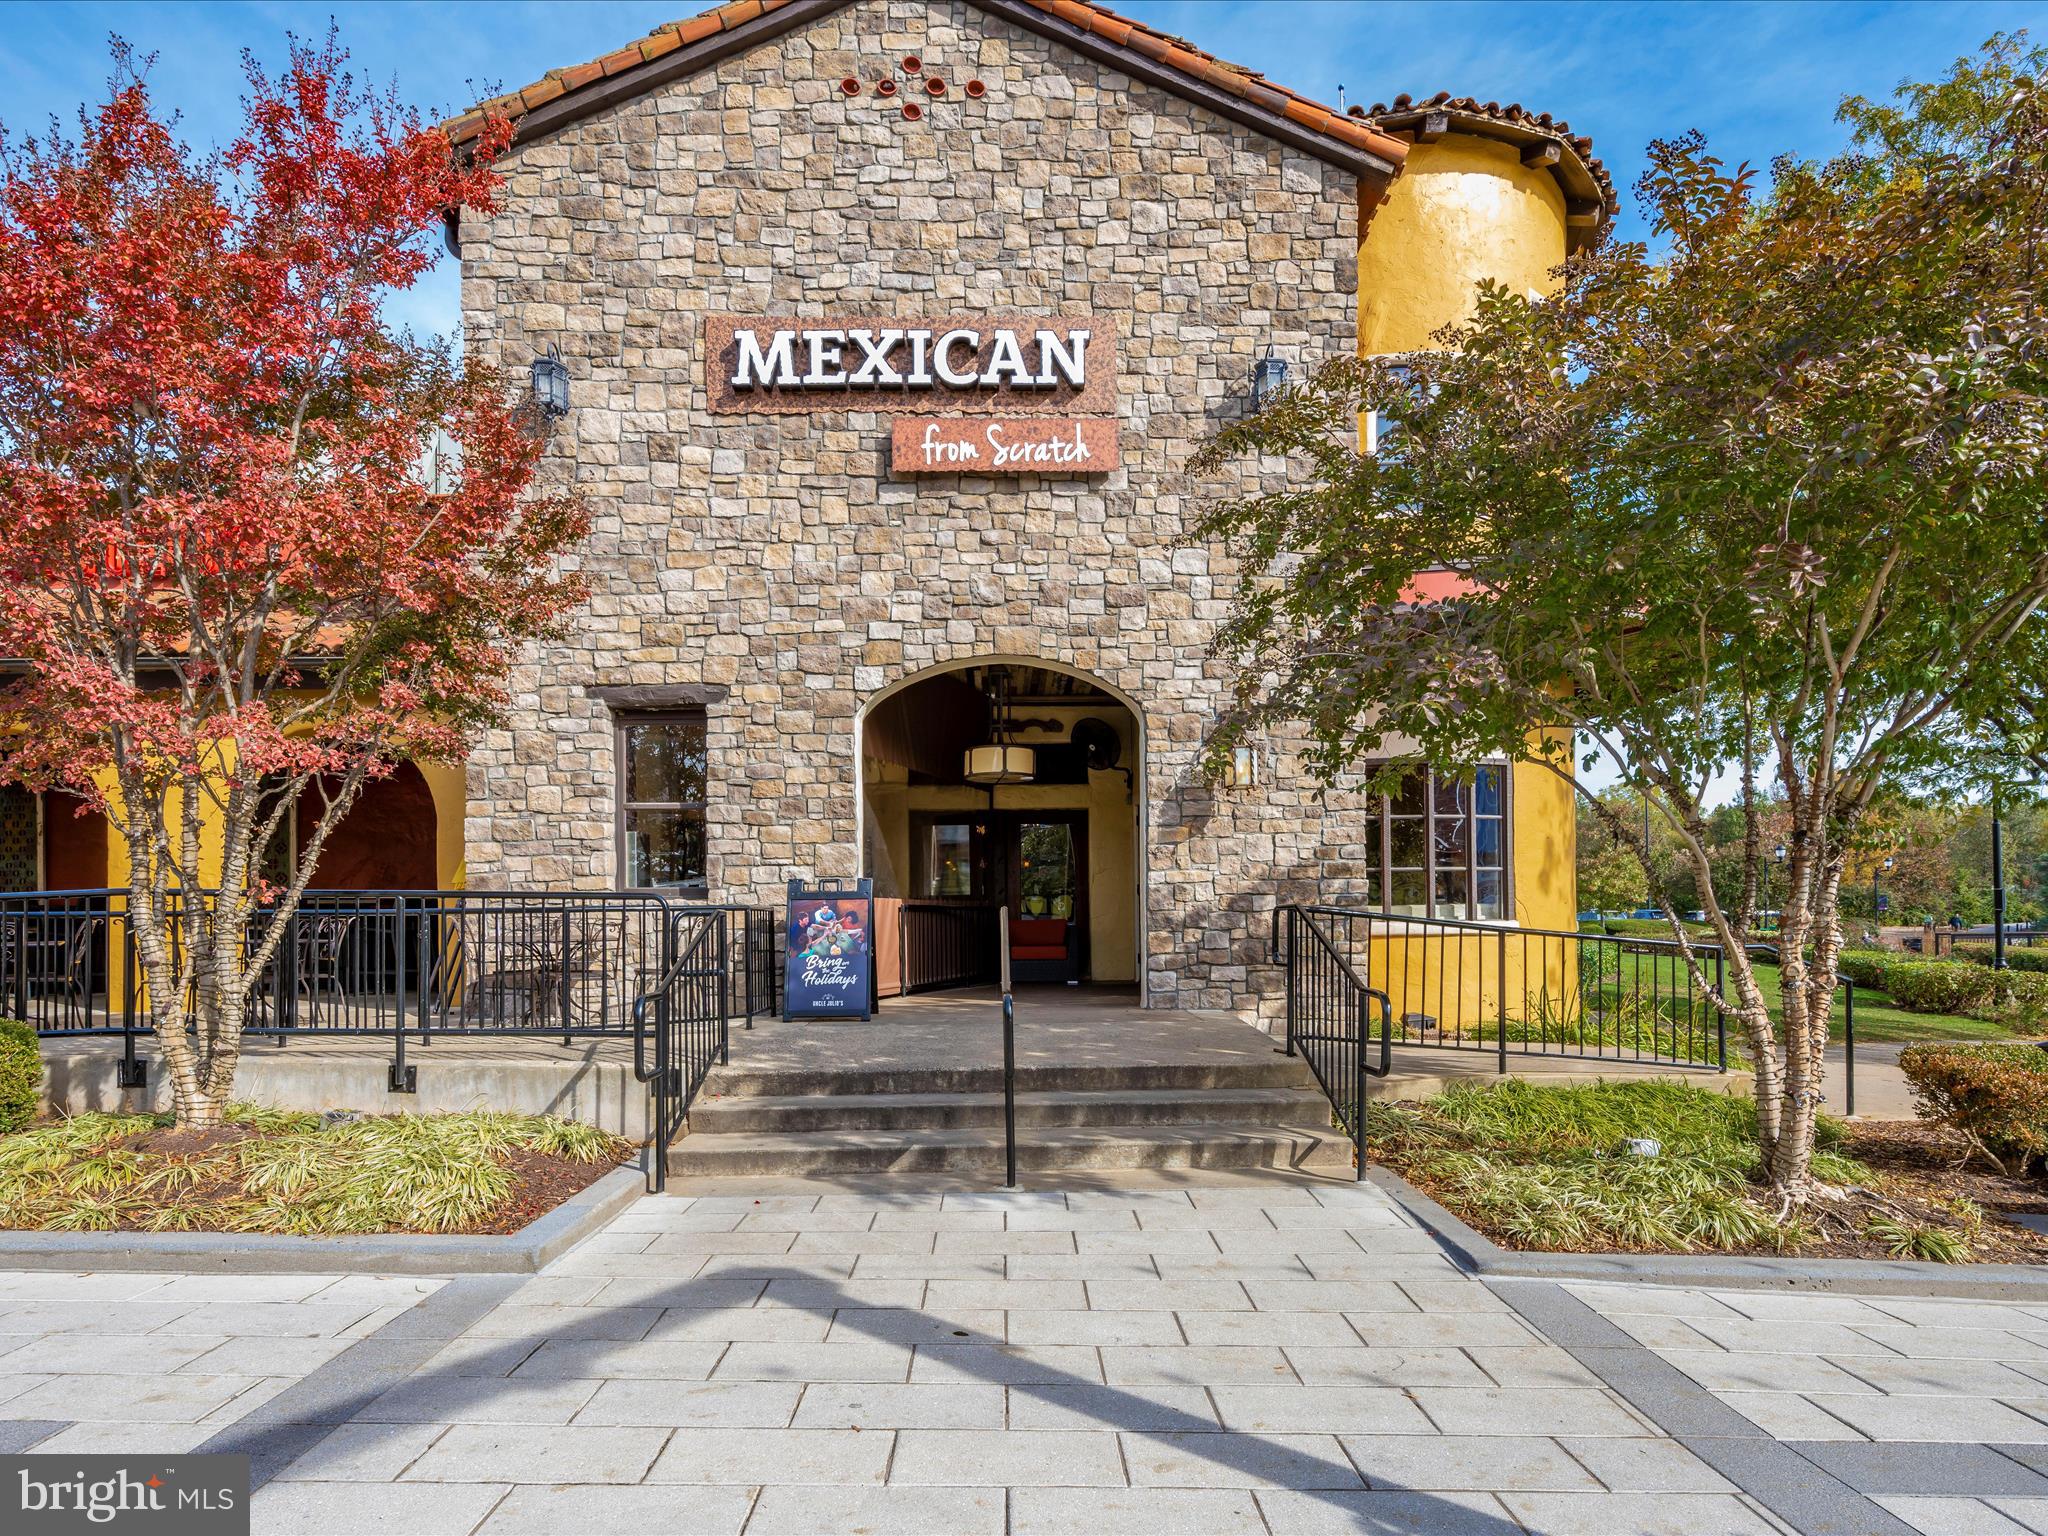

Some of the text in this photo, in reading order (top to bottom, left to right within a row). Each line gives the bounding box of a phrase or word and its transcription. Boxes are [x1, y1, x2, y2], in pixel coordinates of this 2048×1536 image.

[730, 328, 1092, 388] MEXICAN
[920, 422, 1092, 467] from Scratch
[801, 969, 859, 990] Holidays
[805, 954, 847, 972] Bring
